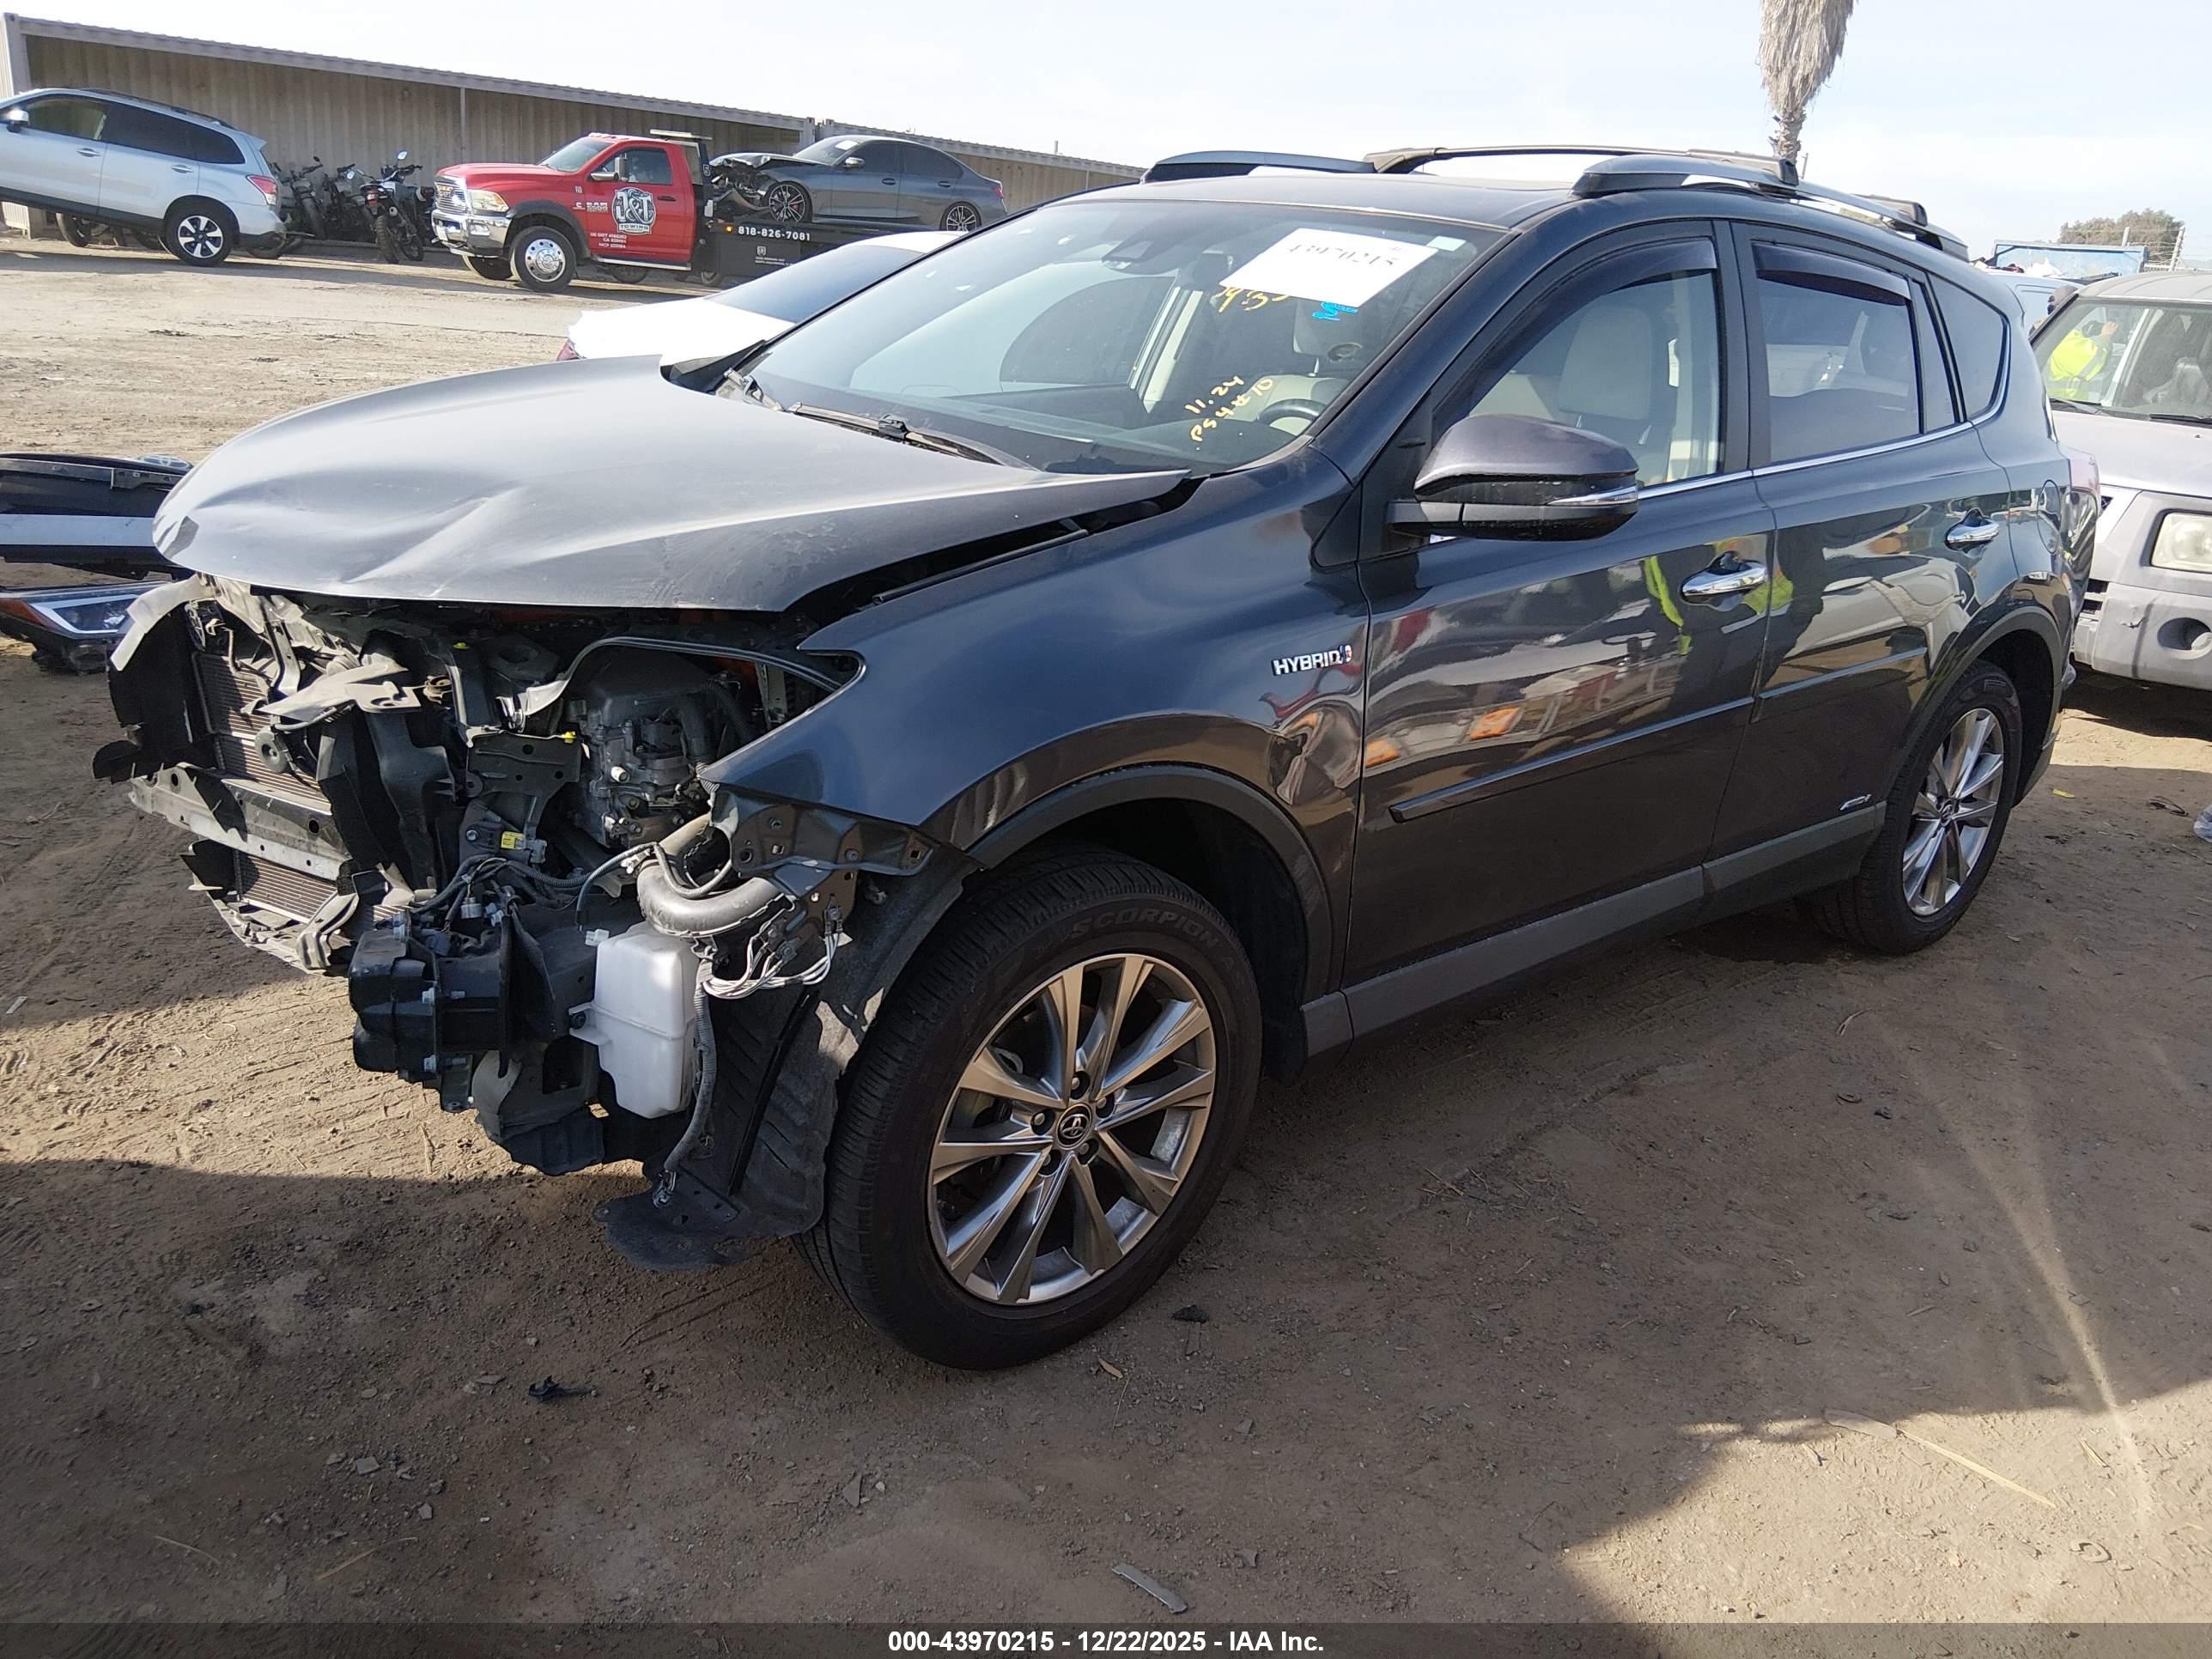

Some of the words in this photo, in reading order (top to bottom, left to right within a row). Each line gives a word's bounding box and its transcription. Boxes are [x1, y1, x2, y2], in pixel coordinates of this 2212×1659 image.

[738, 226, 811, 241] 818-826-7081
[1273, 650, 1343, 676] HYBRID
[1070, 908, 1220, 948] SCORPION
